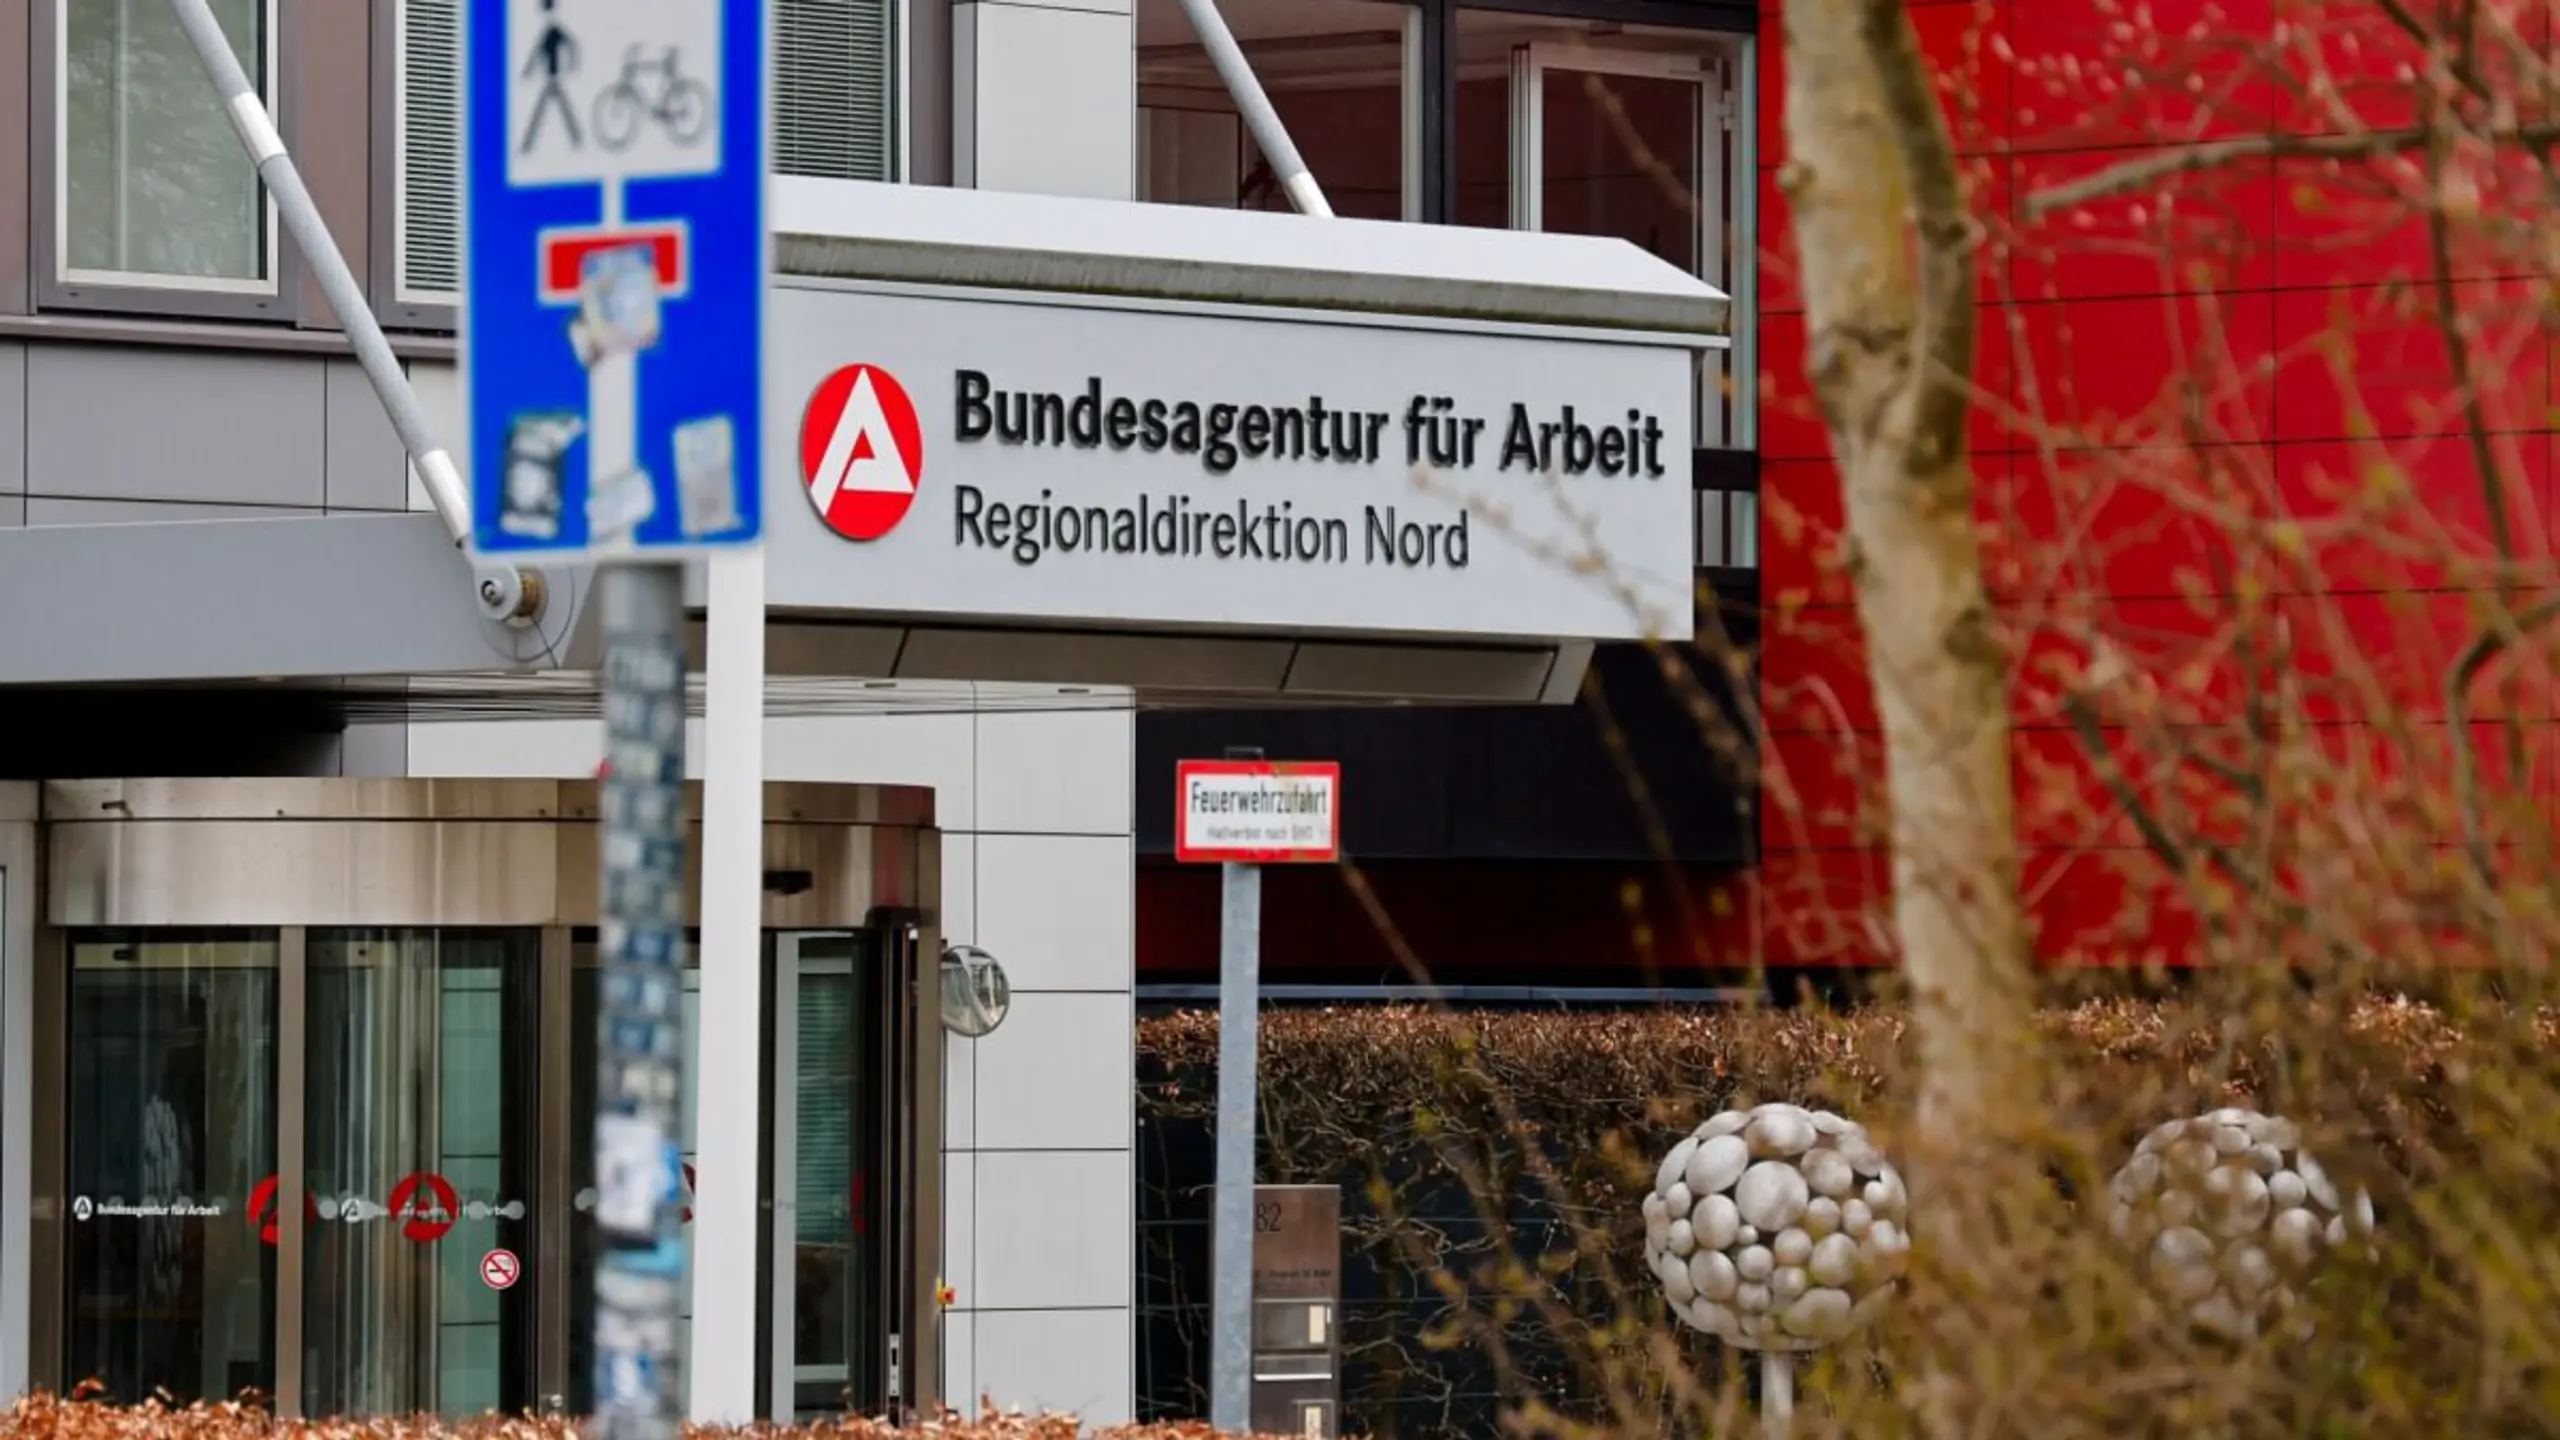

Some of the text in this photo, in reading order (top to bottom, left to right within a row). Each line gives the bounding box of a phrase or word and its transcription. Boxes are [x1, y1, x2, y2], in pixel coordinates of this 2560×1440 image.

[954, 369, 1666, 477] Bundesagentur für Arbeit
[954, 484, 1470, 568] Regionaldirektion Nord
[1191, 780, 1329, 815] Feuerwehrzufahrt
